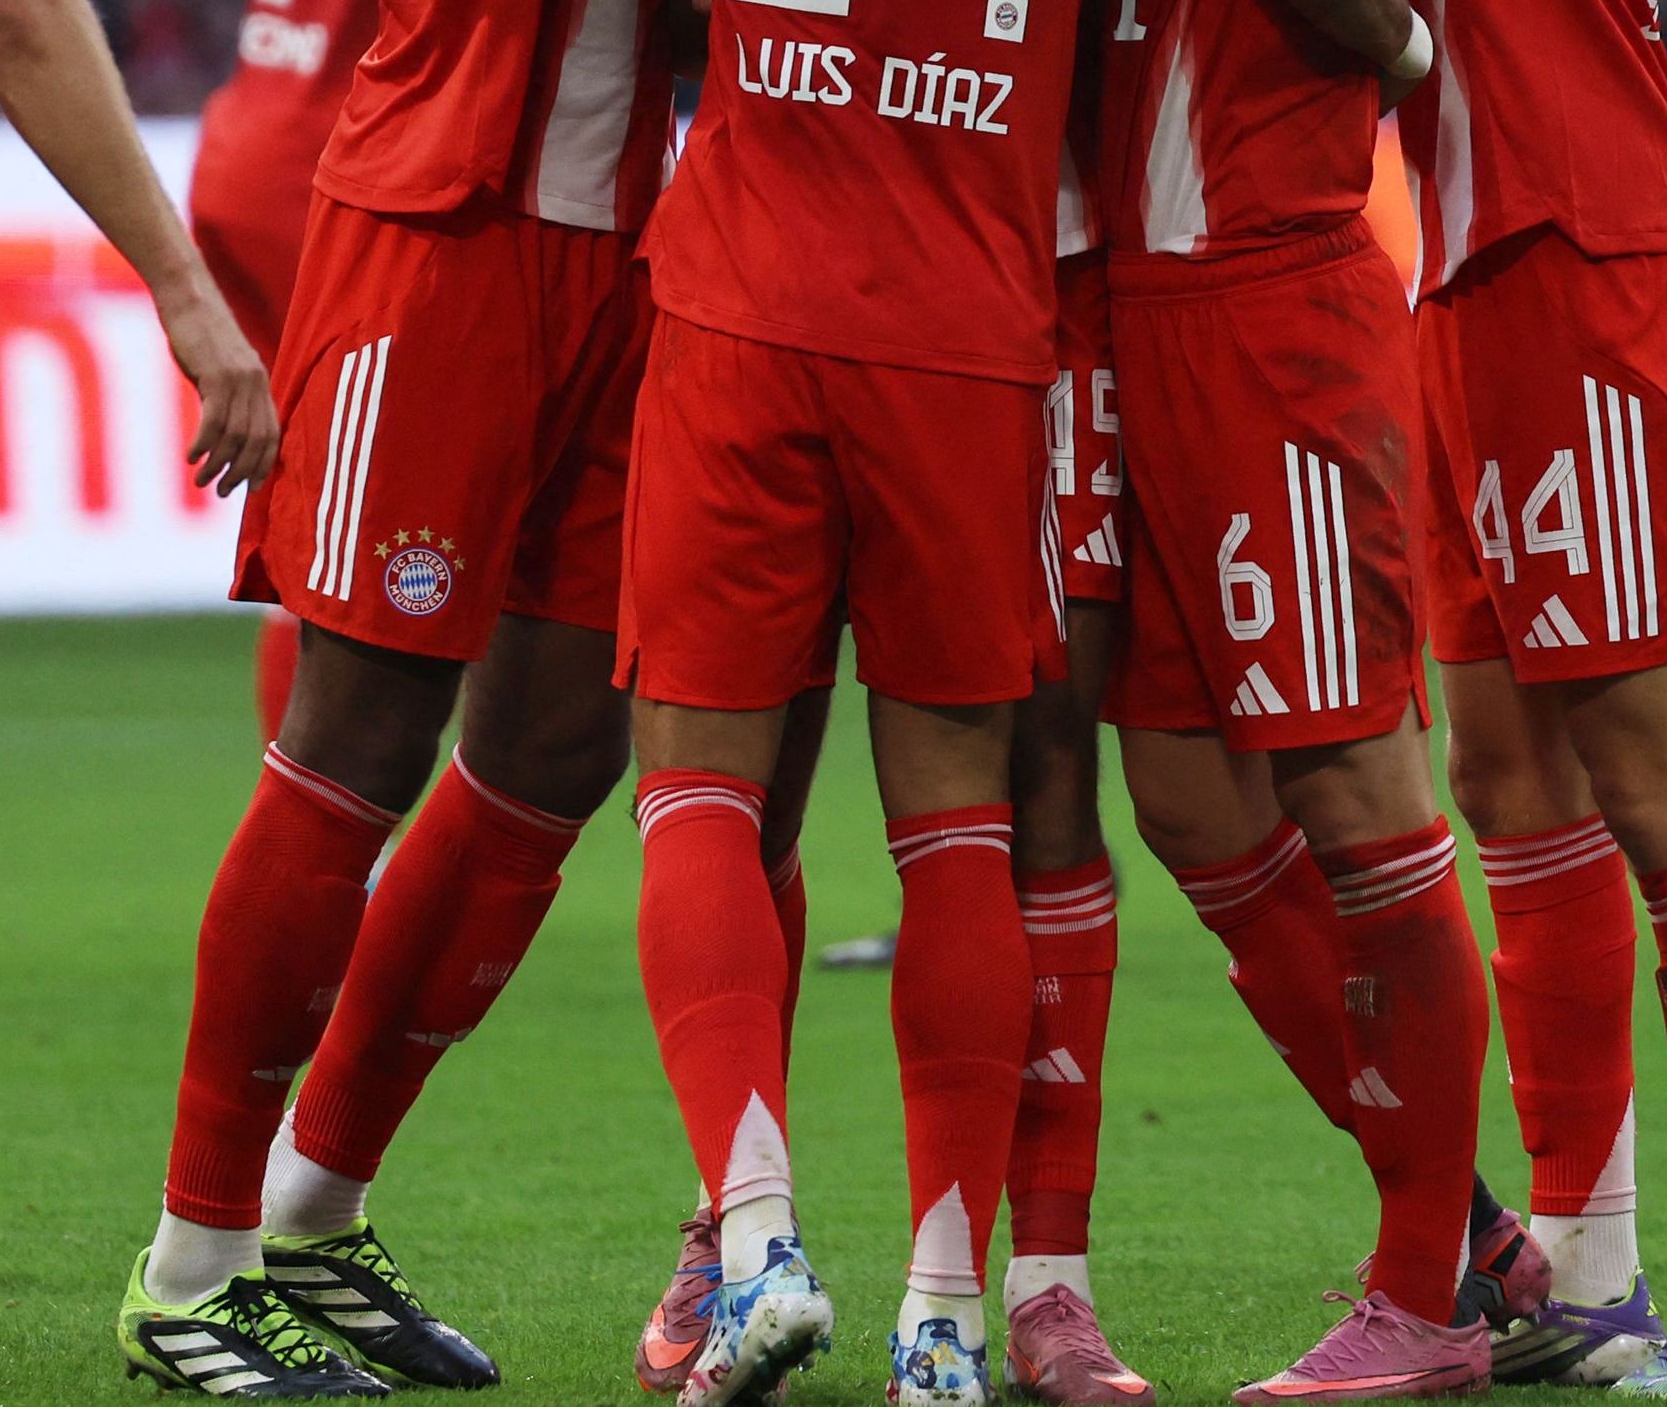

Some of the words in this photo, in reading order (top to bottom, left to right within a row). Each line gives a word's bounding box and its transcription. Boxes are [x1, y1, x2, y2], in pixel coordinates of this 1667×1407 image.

[736, 32, 856, 107] LUIS
[877, 51, 1014, 135] DÍAZ
[392, 558, 406, 574] FC
[407, 552, 448, 581] BAYERN
[1472, 448, 1590, 584] 44
[1217, 512, 1275, 641] 6
